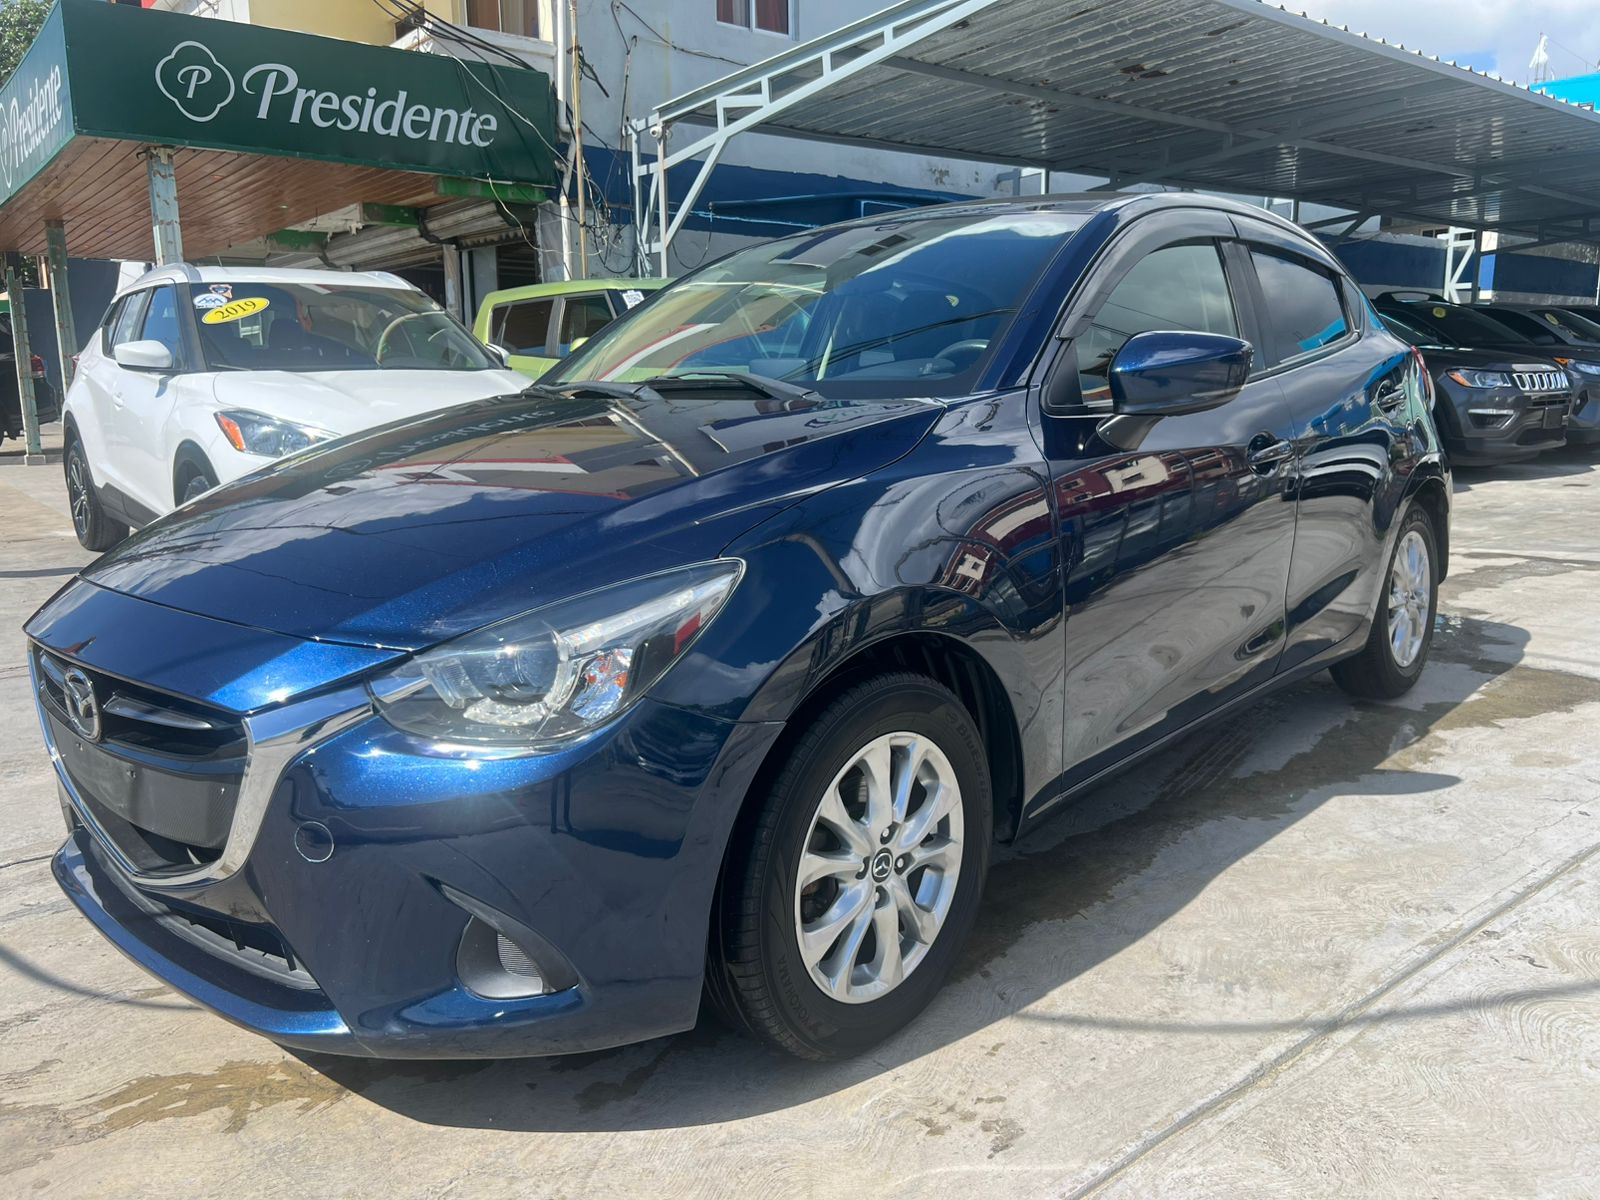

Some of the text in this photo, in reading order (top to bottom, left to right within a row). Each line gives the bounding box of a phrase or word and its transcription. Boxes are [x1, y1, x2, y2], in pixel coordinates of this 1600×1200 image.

[10, 64, 62, 168] Presidente
[177, 63, 498, 148] P Presidente
[214, 300, 257, 319] 2019
[777, 953, 809, 1026] YOKOHAMA
